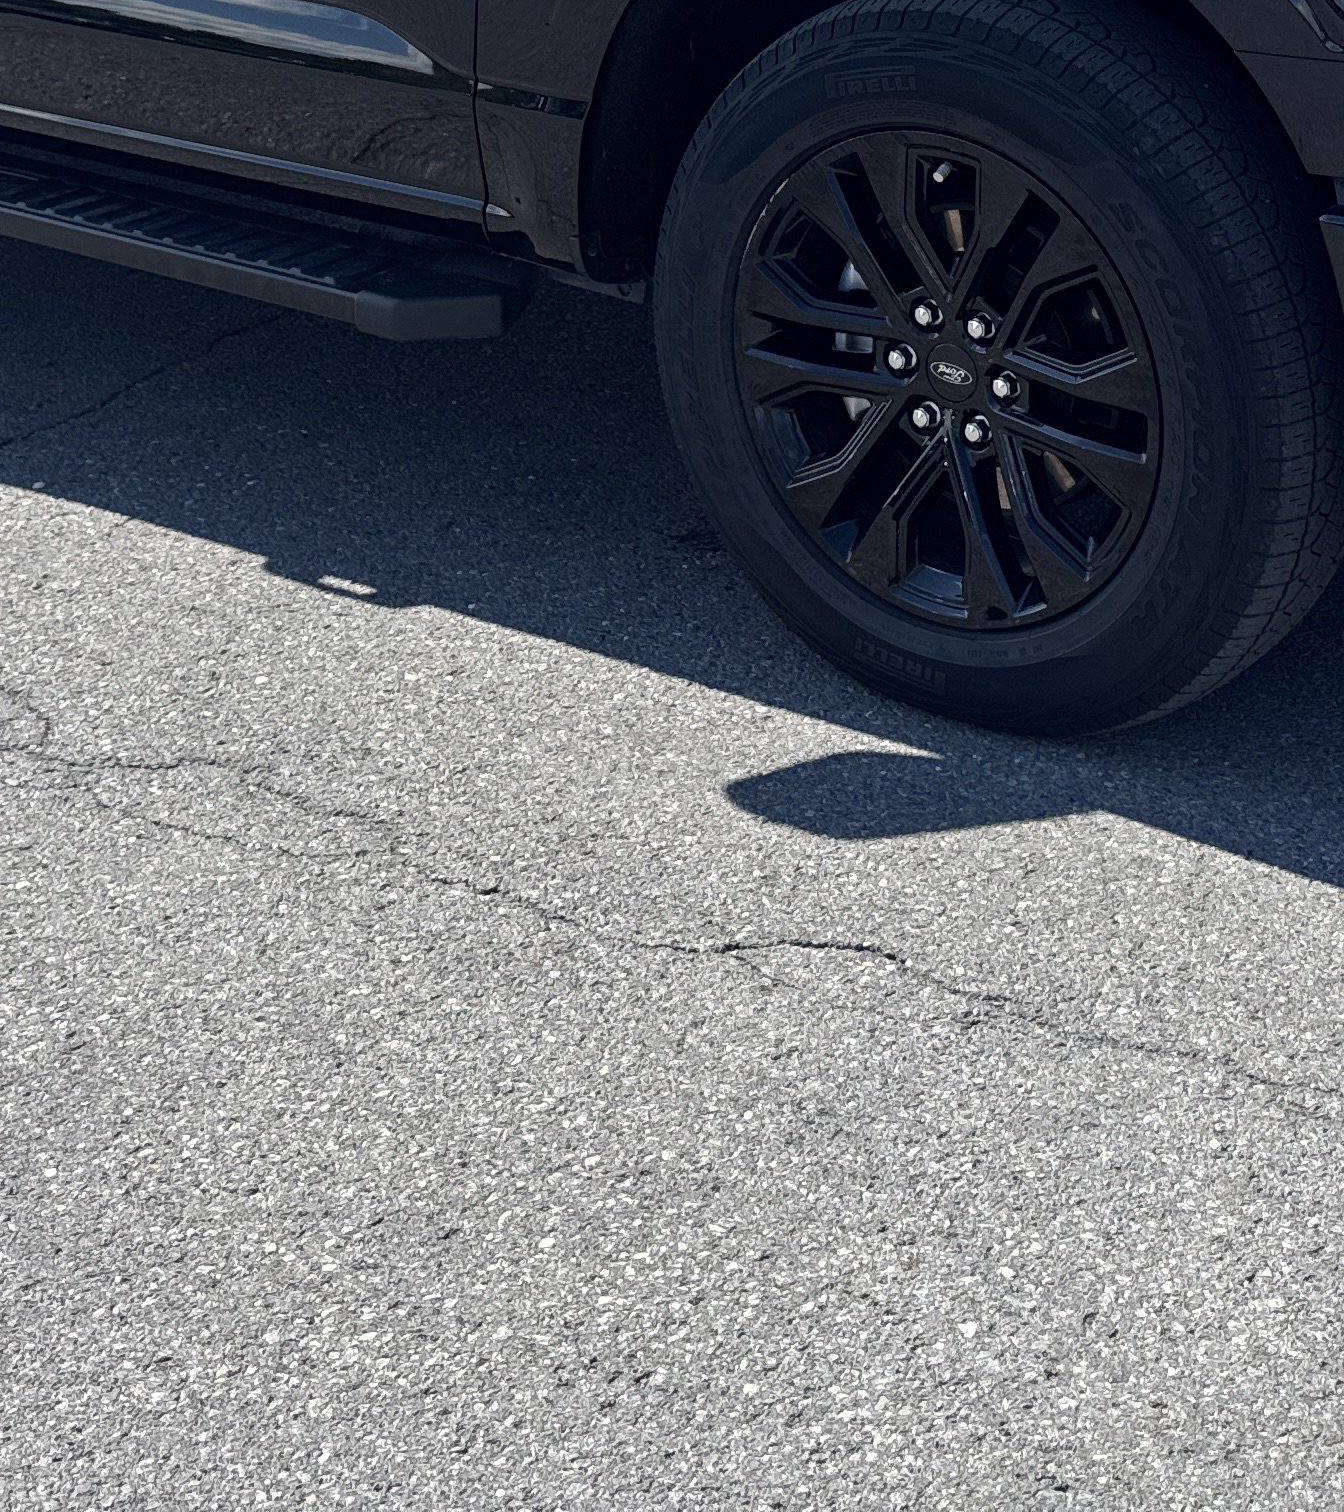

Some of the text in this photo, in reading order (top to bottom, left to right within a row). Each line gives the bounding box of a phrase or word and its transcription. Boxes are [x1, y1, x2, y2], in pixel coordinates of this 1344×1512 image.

[824, 65, 917, 99] PIRELLI
[936, 363, 965, 383] Ford
[1107, 199, 1216, 529] SCORPION
[854, 637, 946, 695] PIRELLI
